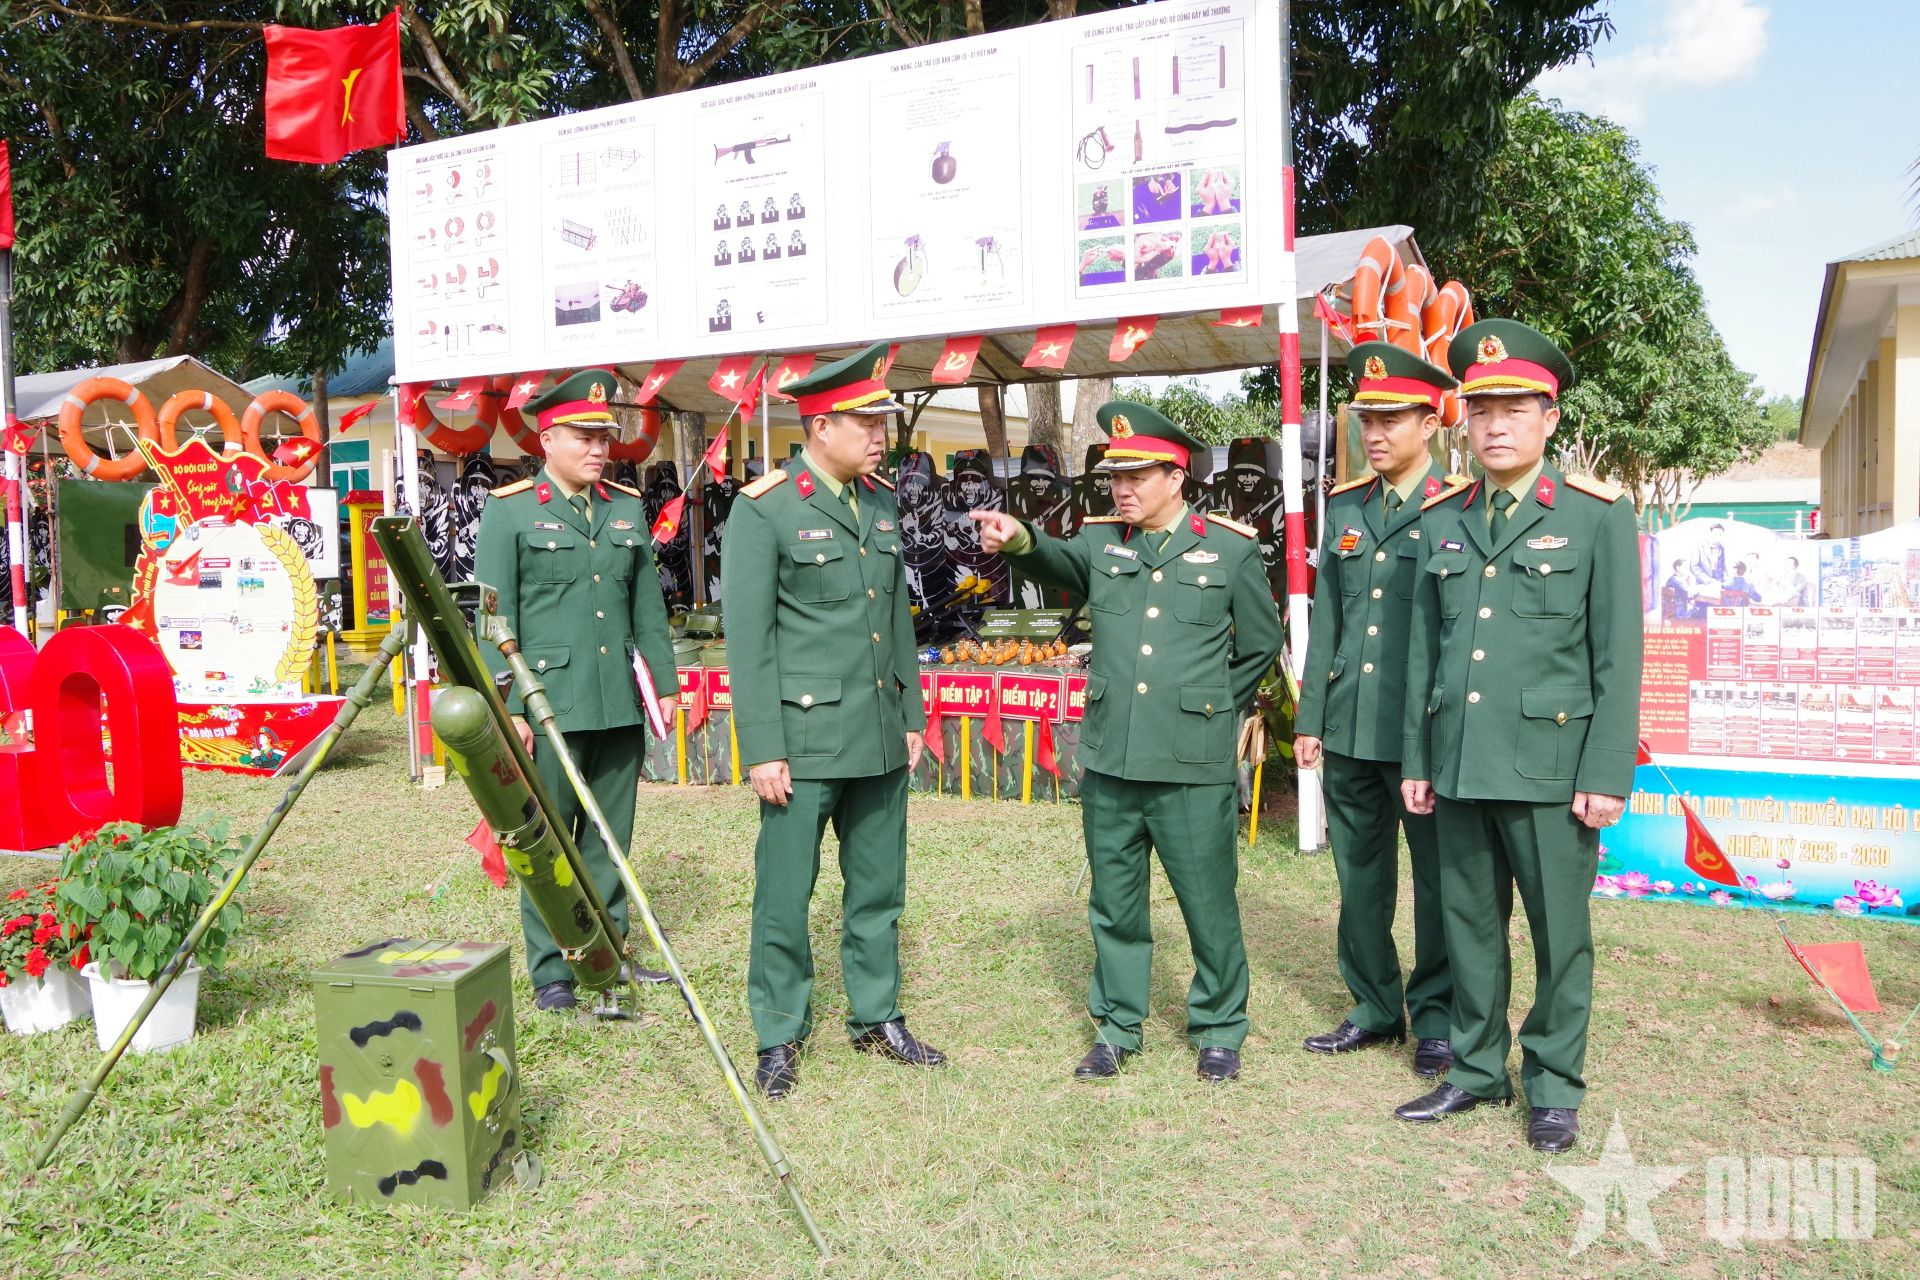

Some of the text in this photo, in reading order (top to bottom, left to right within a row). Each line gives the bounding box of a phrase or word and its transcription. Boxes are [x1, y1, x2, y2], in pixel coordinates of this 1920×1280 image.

[174, 465, 183, 475] BỘ
[184, 463, 196, 474] ĐỘI
[197, 463, 206, 473] CỤ
[940, 681, 963, 703] ĐIỂM
[965, 685, 983, 707] TẬP
[984, 688, 990, 704] 1
[1002, 683, 1056, 711] ĐIỂM TẬP 2
[1630, 788, 1664, 815] HÌNH
[1704, 797, 1734, 823] DỤC
[1738, 796, 1784, 823] TUYÊN
[1851, 806, 1878, 833] ĐẠI
[1881, 804, 1908, 836] HỘI
[1725, 832, 1773, 862] NHIỆM
[1800, 840, 1837, 864] 2025
[1851, 844, 1891, 868] 2030
